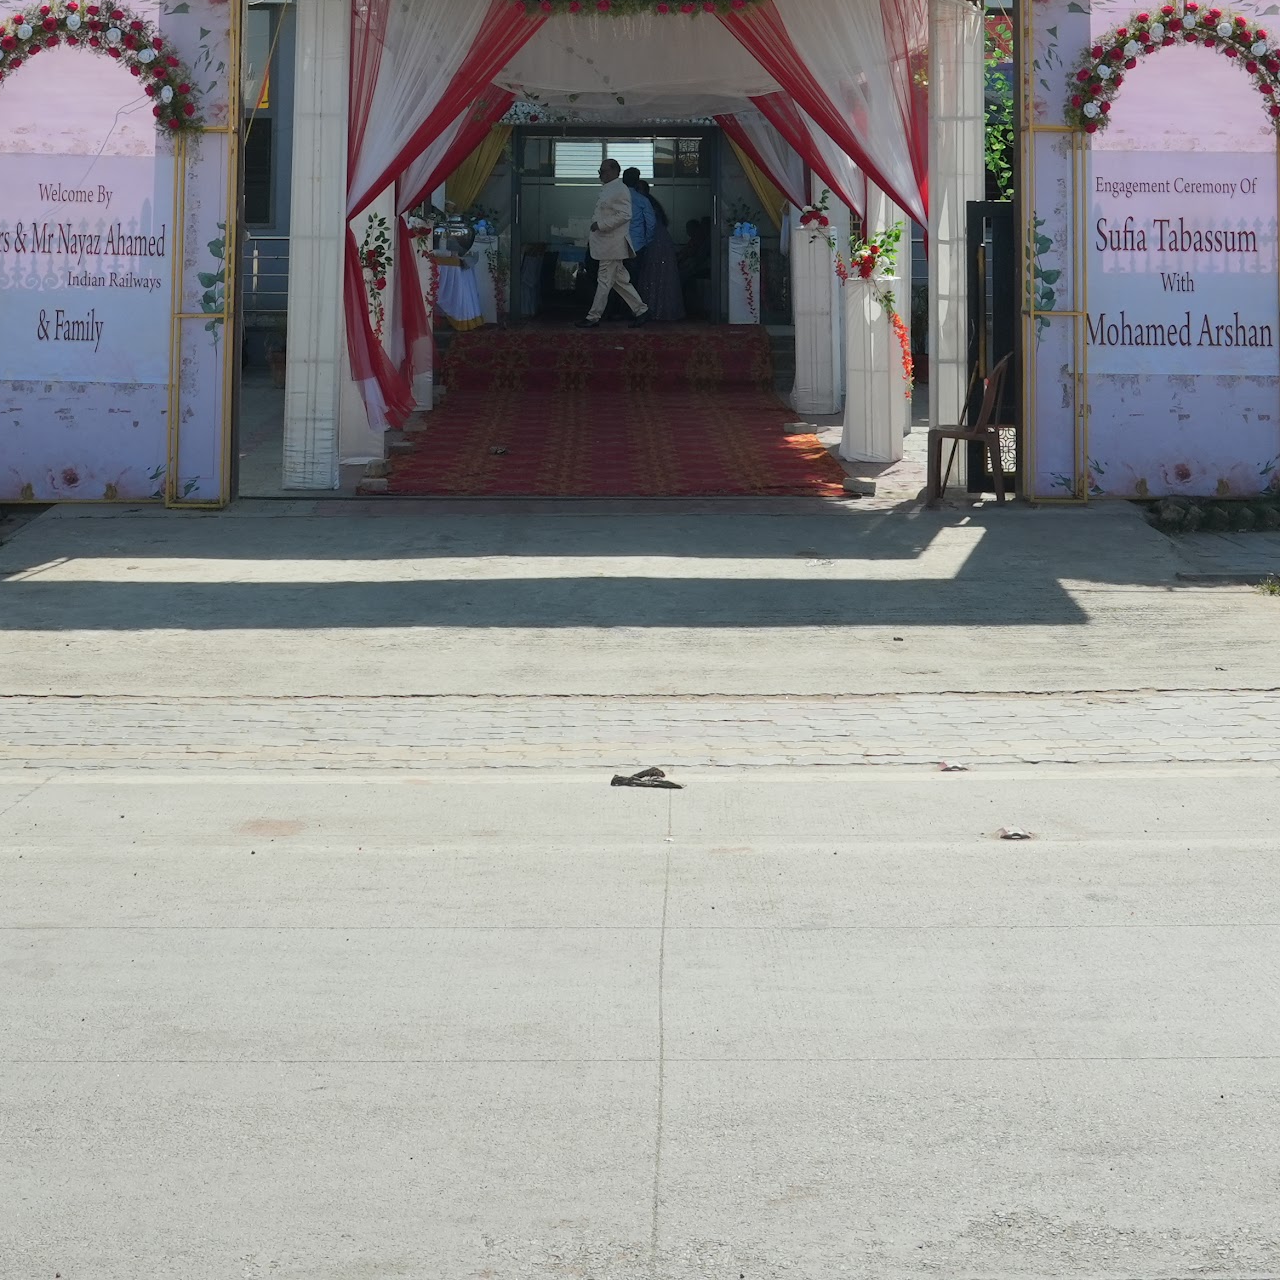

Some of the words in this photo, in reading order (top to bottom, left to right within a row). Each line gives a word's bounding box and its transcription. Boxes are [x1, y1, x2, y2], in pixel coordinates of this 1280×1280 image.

[38, 183, 94, 203] Welcome
[97, 185, 113, 209] By
[1095, 176, 1170, 198] Engagement
[1174, 177, 1236, 198] Ceremony
[1240, 177, 1257, 194] Of
[14, 222, 27, 254] &
[31, 222, 53, 254] Mr
[57, 223, 100, 265] Nayaz
[104, 223, 166, 257] Ahamed
[1096, 216, 1147, 252] Sufia
[1153, 217, 1257, 252] Tabassum
[67, 271, 105, 287] Indian
[109, 272, 161, 293] Railways
[1160, 272, 1194, 292] With
[37, 309, 50, 341] &
[54, 309, 103, 352] Family
[1086, 311, 1190, 346] Mohamed
[1197, 312, 1273, 347] Arshan
